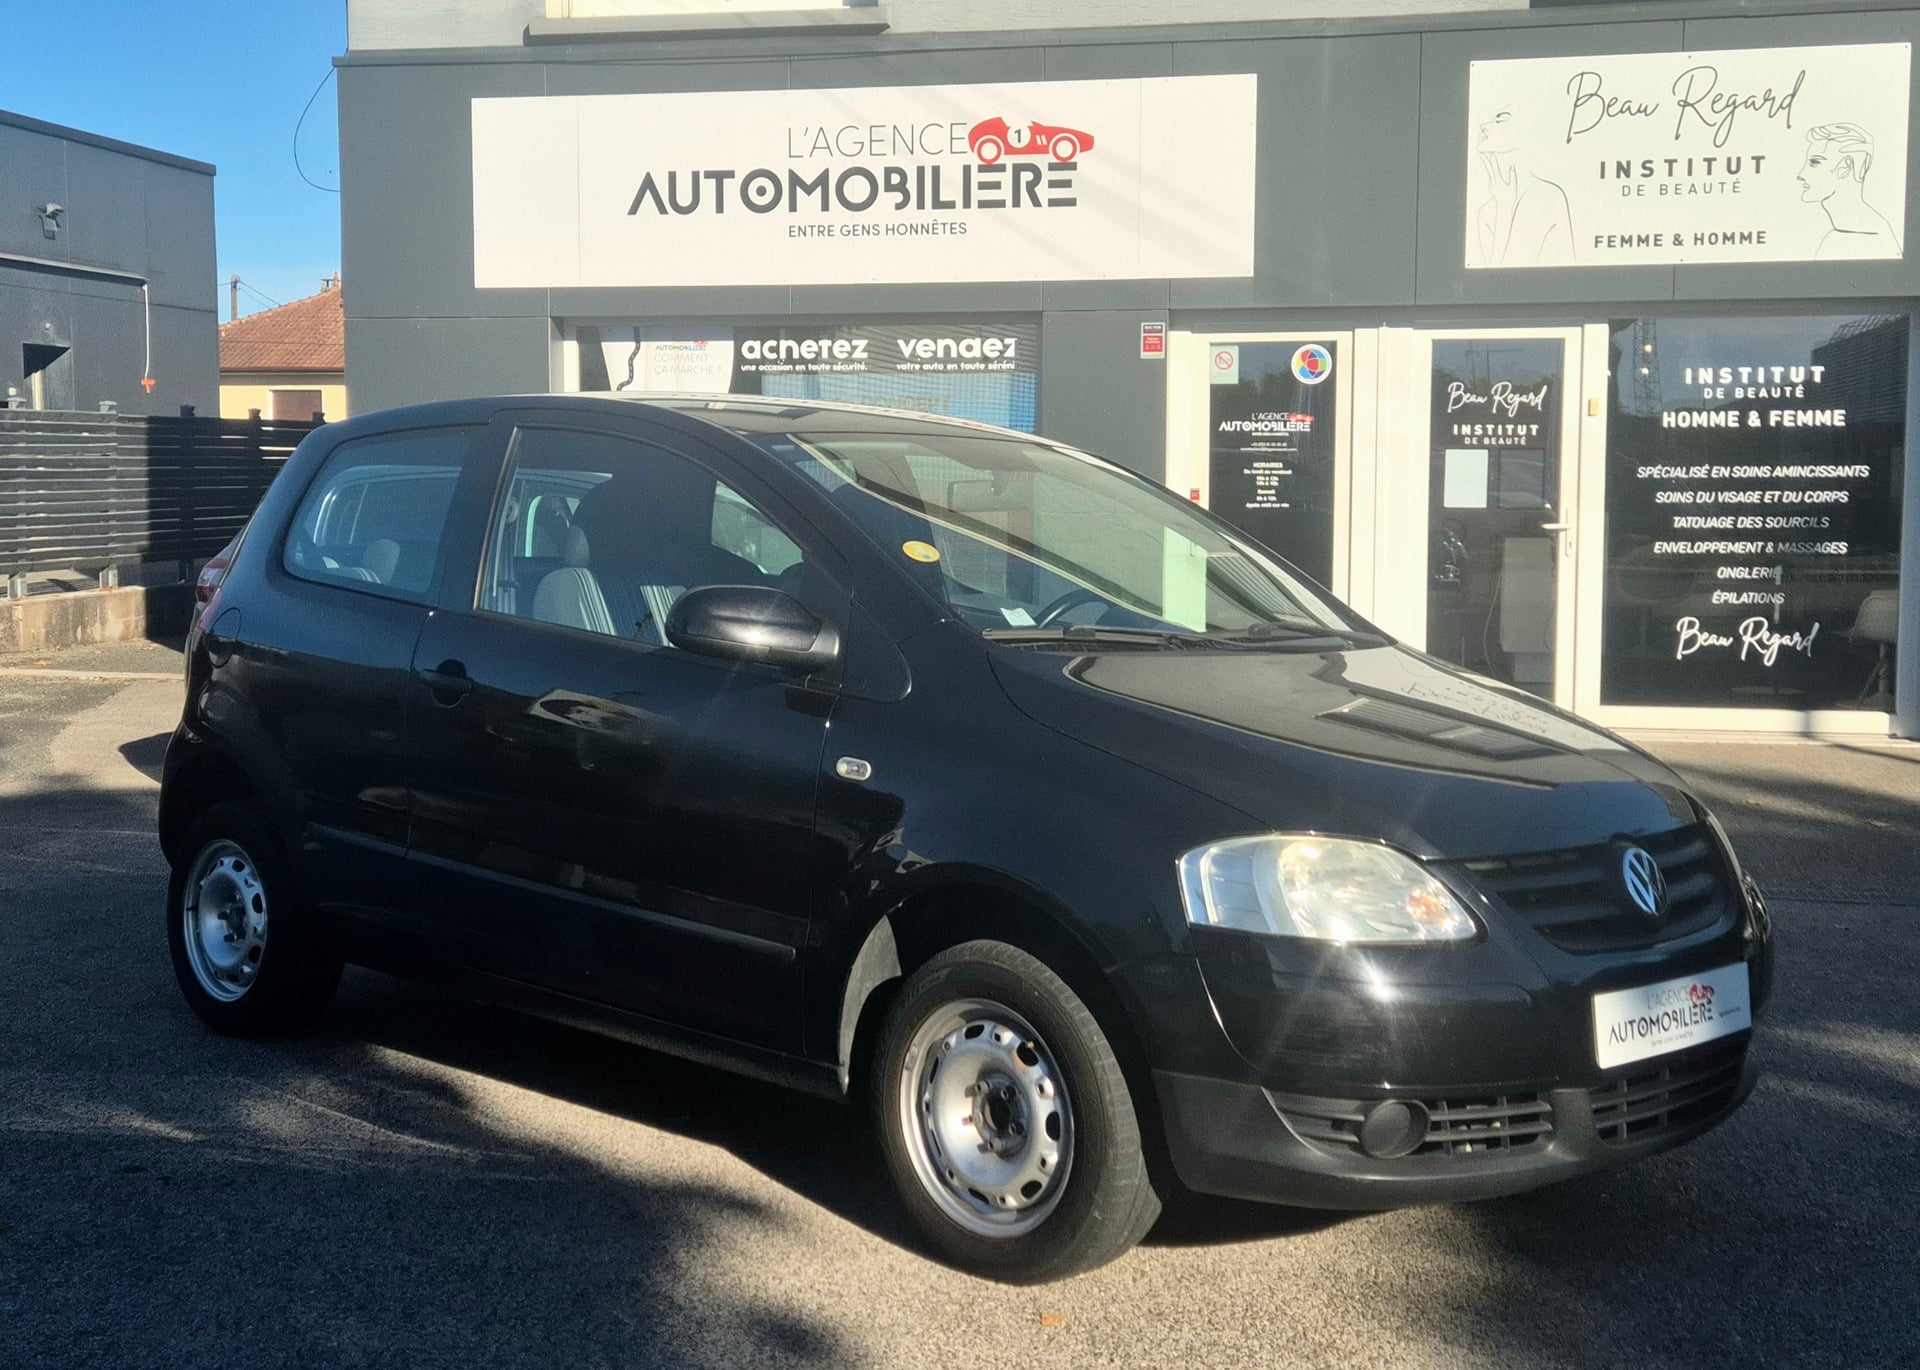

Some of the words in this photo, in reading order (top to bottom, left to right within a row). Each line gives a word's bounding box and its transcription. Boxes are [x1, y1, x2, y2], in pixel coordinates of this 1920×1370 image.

[1566, 72, 1660, 144] Beau
[1671, 66, 1807, 148] Regard
[788, 123, 968, 158] L'AGENCE
[1014, 129, 1022, 143] 1
[1599, 156, 1766, 180] INSTITUT
[1621, 185, 1646, 196] DE
[1659, 178, 1741, 195] BEAUTÉ
[788, 225, 835, 237] ENTRE
[839, 224, 881, 236] GENS
[885, 219, 968, 235] HONNÊTES
[1594, 234, 1664, 248] FEMME
[1672, 234, 1684, 246] &
[1693, 231, 1767, 246] HOMME
[654, 353, 709, 363] COMMENT
[670, 365, 713, 375] MARCHE
[758, 362, 794, 371] occasion
[807, 363, 831, 371] toute
[1684, 366, 1825, 385] INSTITUT
[1447, 382, 1488, 412] Beau
[1491, 382, 1548, 417] Regard
[1703, 388, 1725, 399] DE
[1734, 384, 1805, 398] BEAUTÉ
[1662, 411, 1740, 427] HOMME
[1747, 411, 1762, 427] &
[1769, 410, 1846, 426] FEMME
[1453, 424, 1539, 435] INSTITUT
[1636, 464, 1710, 478] SPÉCIALISÉ
[1710, 466, 1731, 478] EN
[1730, 466, 1772, 477] SOINS
[1771, 466, 1870, 477] AMINCISSANTS
[1655, 492, 1695, 503] SOINS
[1695, 492, 1716, 503] DU
[1717, 491, 1763, 503] VISAGE
[1763, 491, 1782, 502] ET
[1782, 491, 1803, 502] DU
[1803, 491, 1850, 502] CORPS
[1673, 517, 1736, 528] TATOUAGE
[1736, 517, 1764, 528] DES
[1765, 515, 1831, 529] SOURCILS
[1653, 542, 1765, 553] ENVELOPPEMENT
[1765, 541, 1775, 554] &
[1777, 540, 1849, 554] MASSAGES
[1711, 589, 1786, 605] ÉPILATIONS
[1676, 617, 1734, 660] Beau
[1737, 614, 1822, 668] Regard
